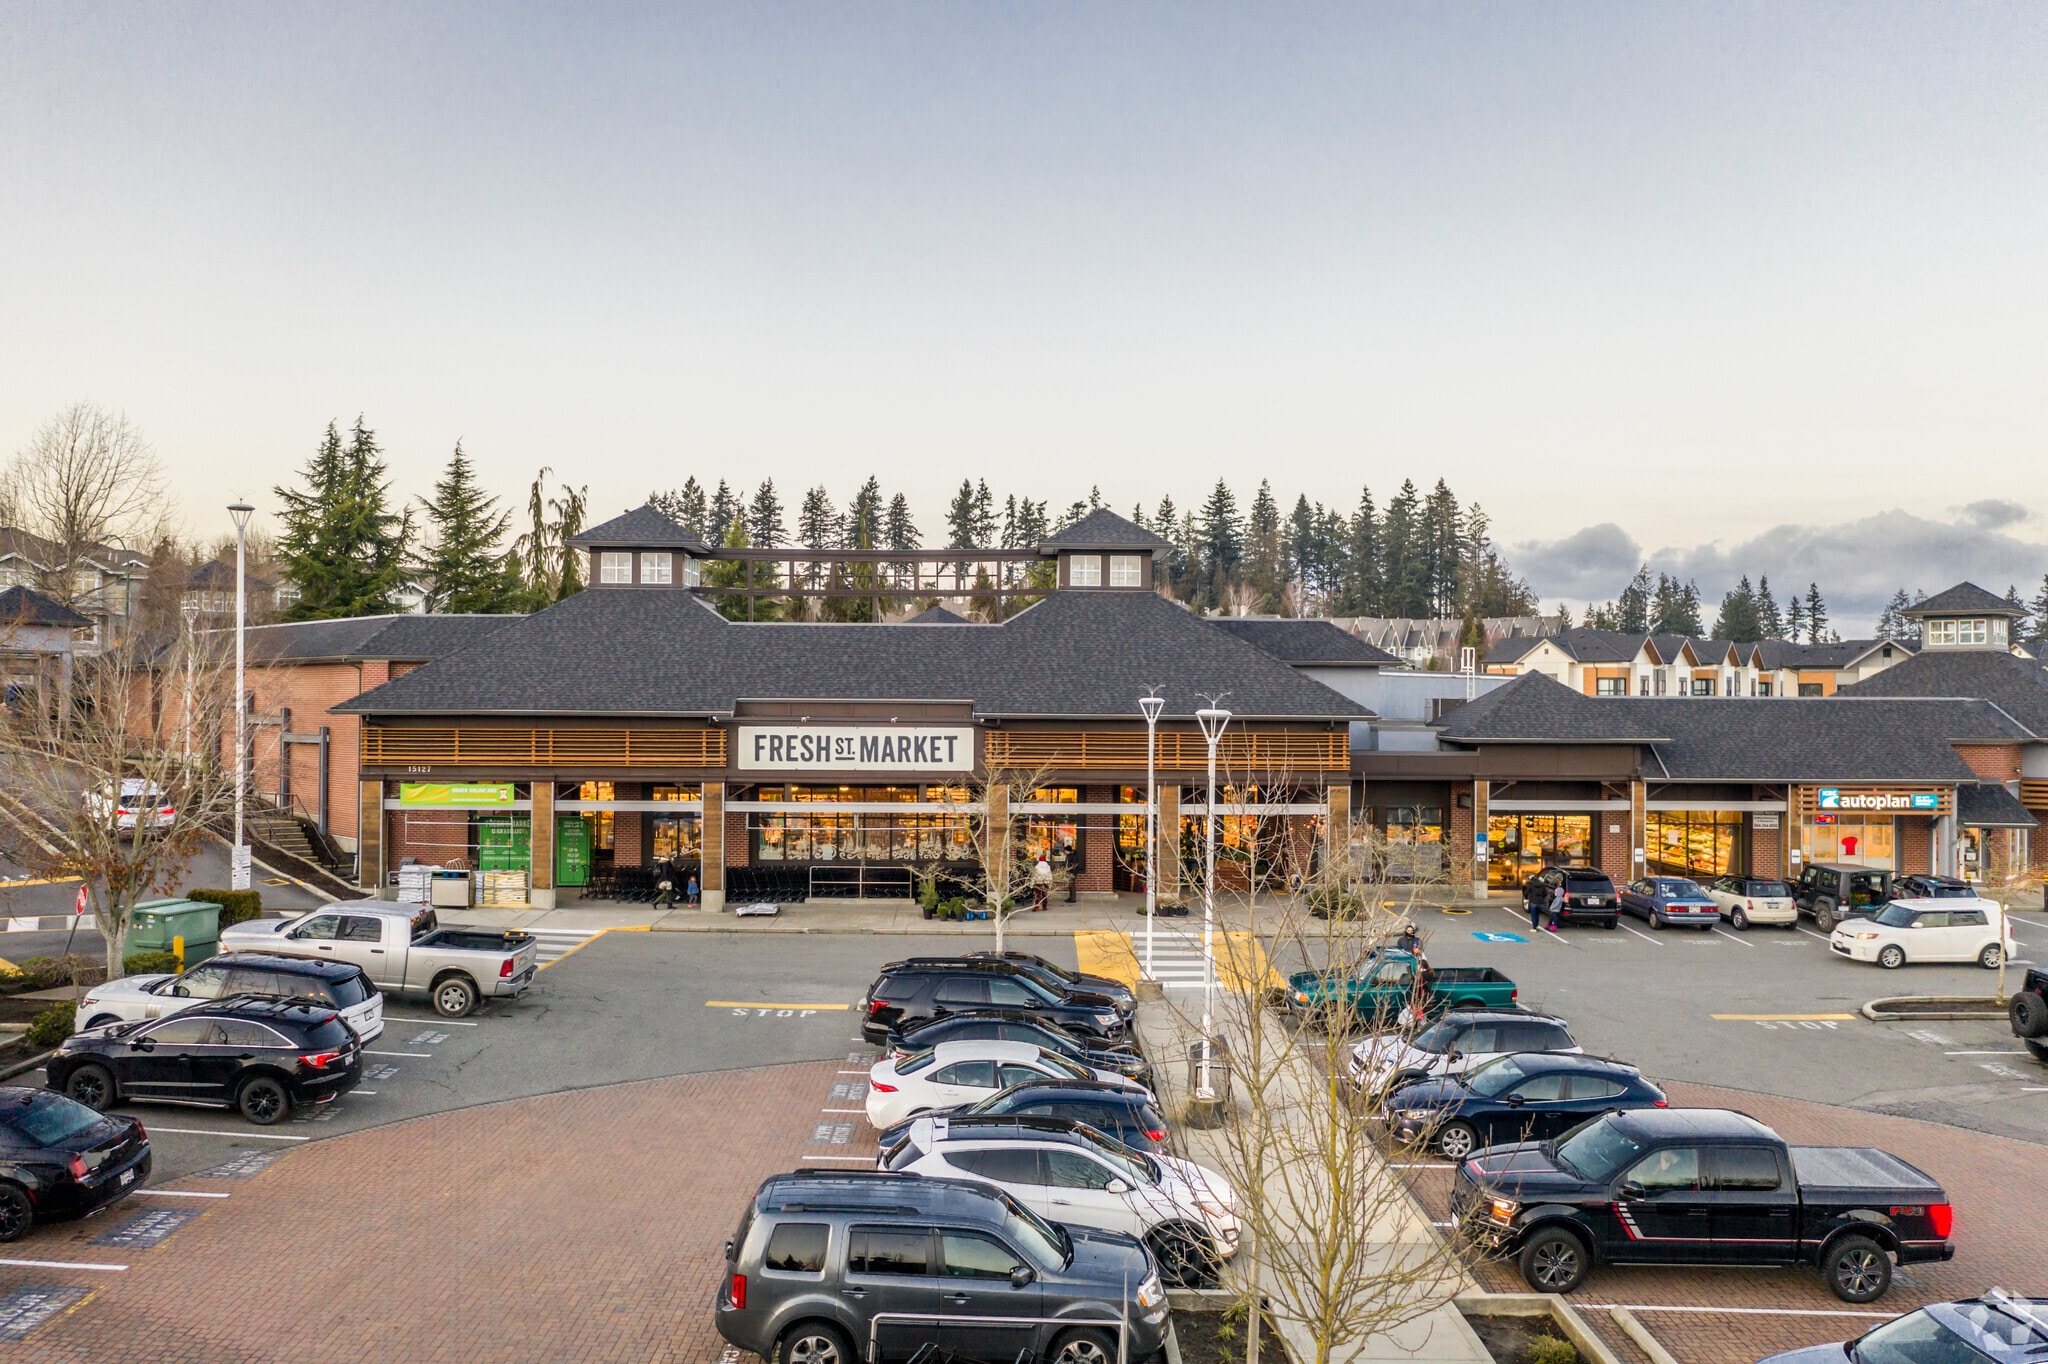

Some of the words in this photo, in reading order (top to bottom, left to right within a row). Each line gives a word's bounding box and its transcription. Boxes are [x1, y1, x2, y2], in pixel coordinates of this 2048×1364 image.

[754, 734, 831, 762] FRESH
[860, 735, 958, 763] MARKET
[408, 765, 432, 773] 15127
[1840, 794, 1910, 810] autoplan
[731, 1007, 817, 1018] STOP
[1754, 1020, 1838, 1030] STOP
[121, 1210, 172, 1235] HOUR
